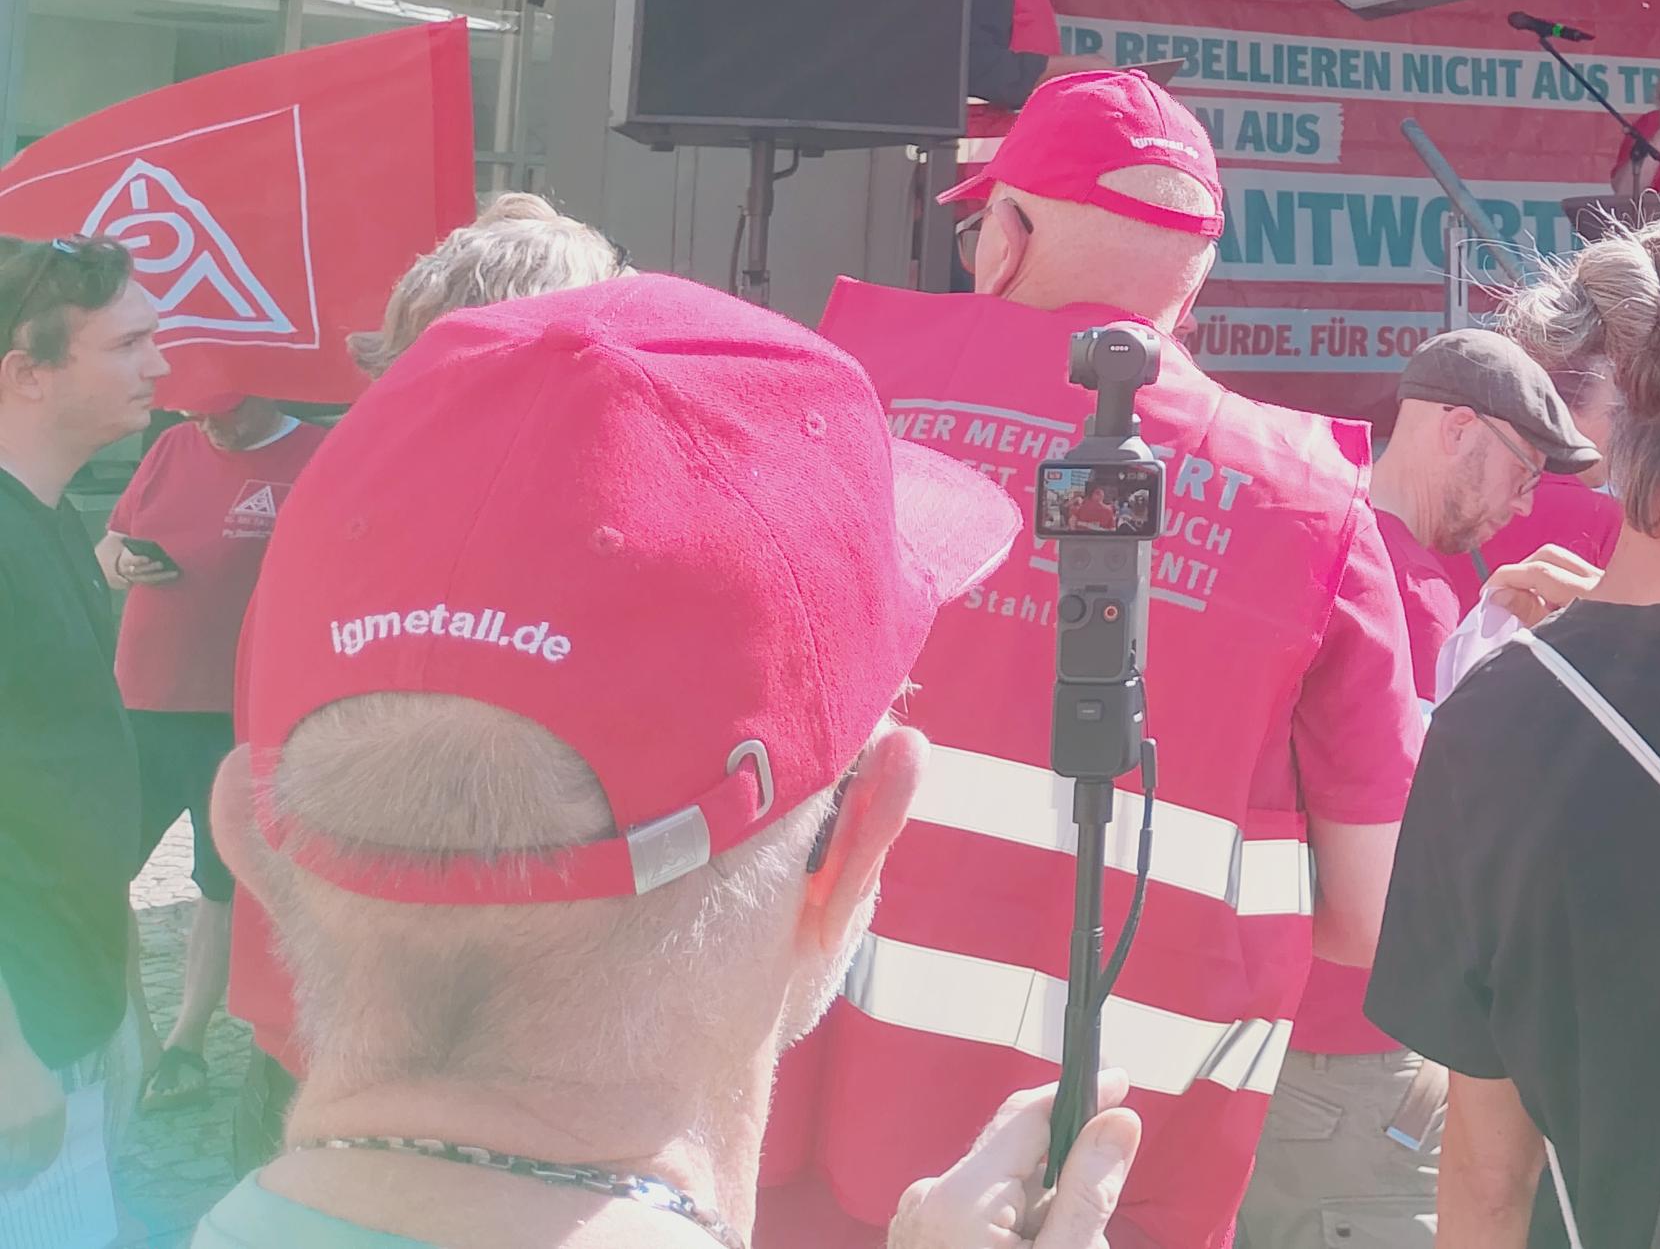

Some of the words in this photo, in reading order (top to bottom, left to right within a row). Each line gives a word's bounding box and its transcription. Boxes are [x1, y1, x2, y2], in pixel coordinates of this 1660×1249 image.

[1060, 25, 1104, 55] IR
[1115, 31, 1392, 92] REBELLIEREN
[1402, 52, 1523, 97] NICHT
[1531, 61, 1609, 103] AUS
[1234, 109, 1321, 155] AUS
[1309, 317, 1369, 358] FÜR
[886, 413, 957, 441] WER
[963, 419, 1072, 461] MEHR
[1160, 508, 1233, 556] UCH
[330, 603, 572, 662] igmetall.de
